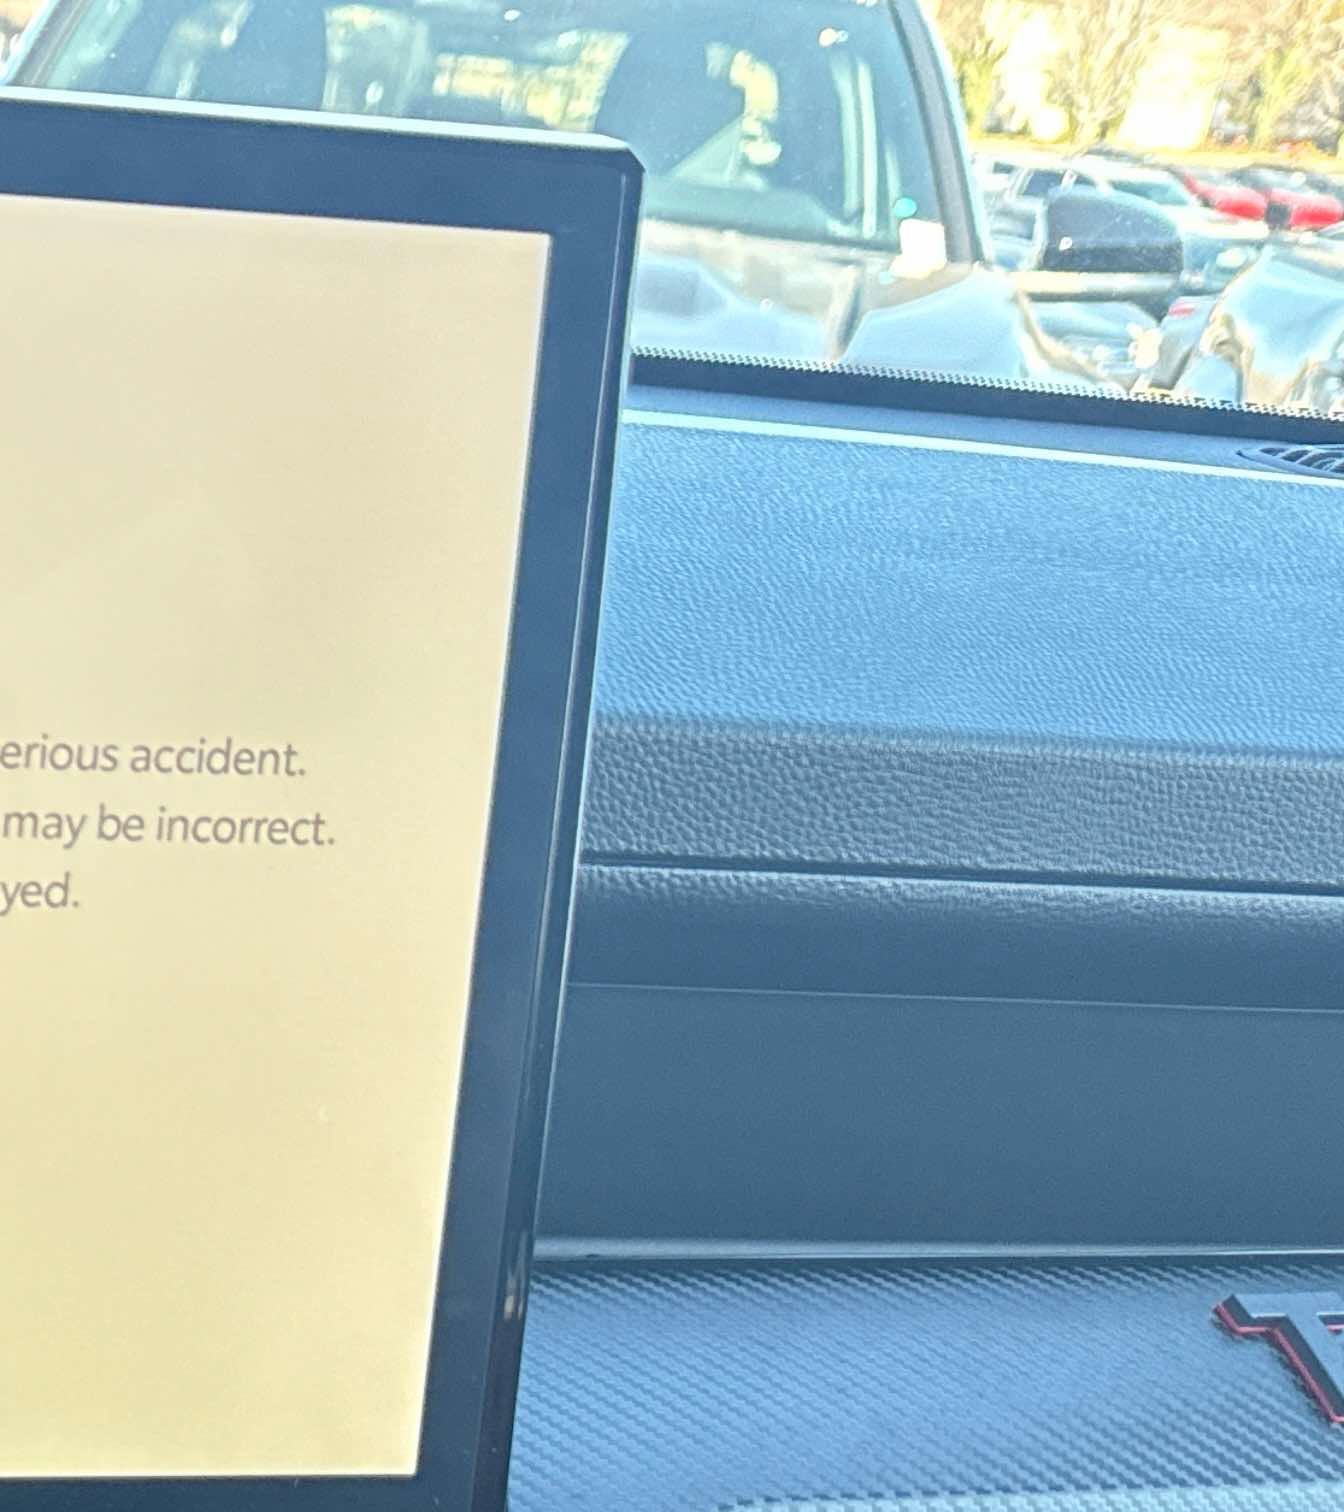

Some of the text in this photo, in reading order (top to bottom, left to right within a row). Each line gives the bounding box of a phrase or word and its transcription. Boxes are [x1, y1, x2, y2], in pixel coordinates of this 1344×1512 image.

[130, 736, 306, 776] accident.
[3, 811, 88, 850] may
[97, 803, 145, 842] be
[156, 806, 335, 846] incorrect.
